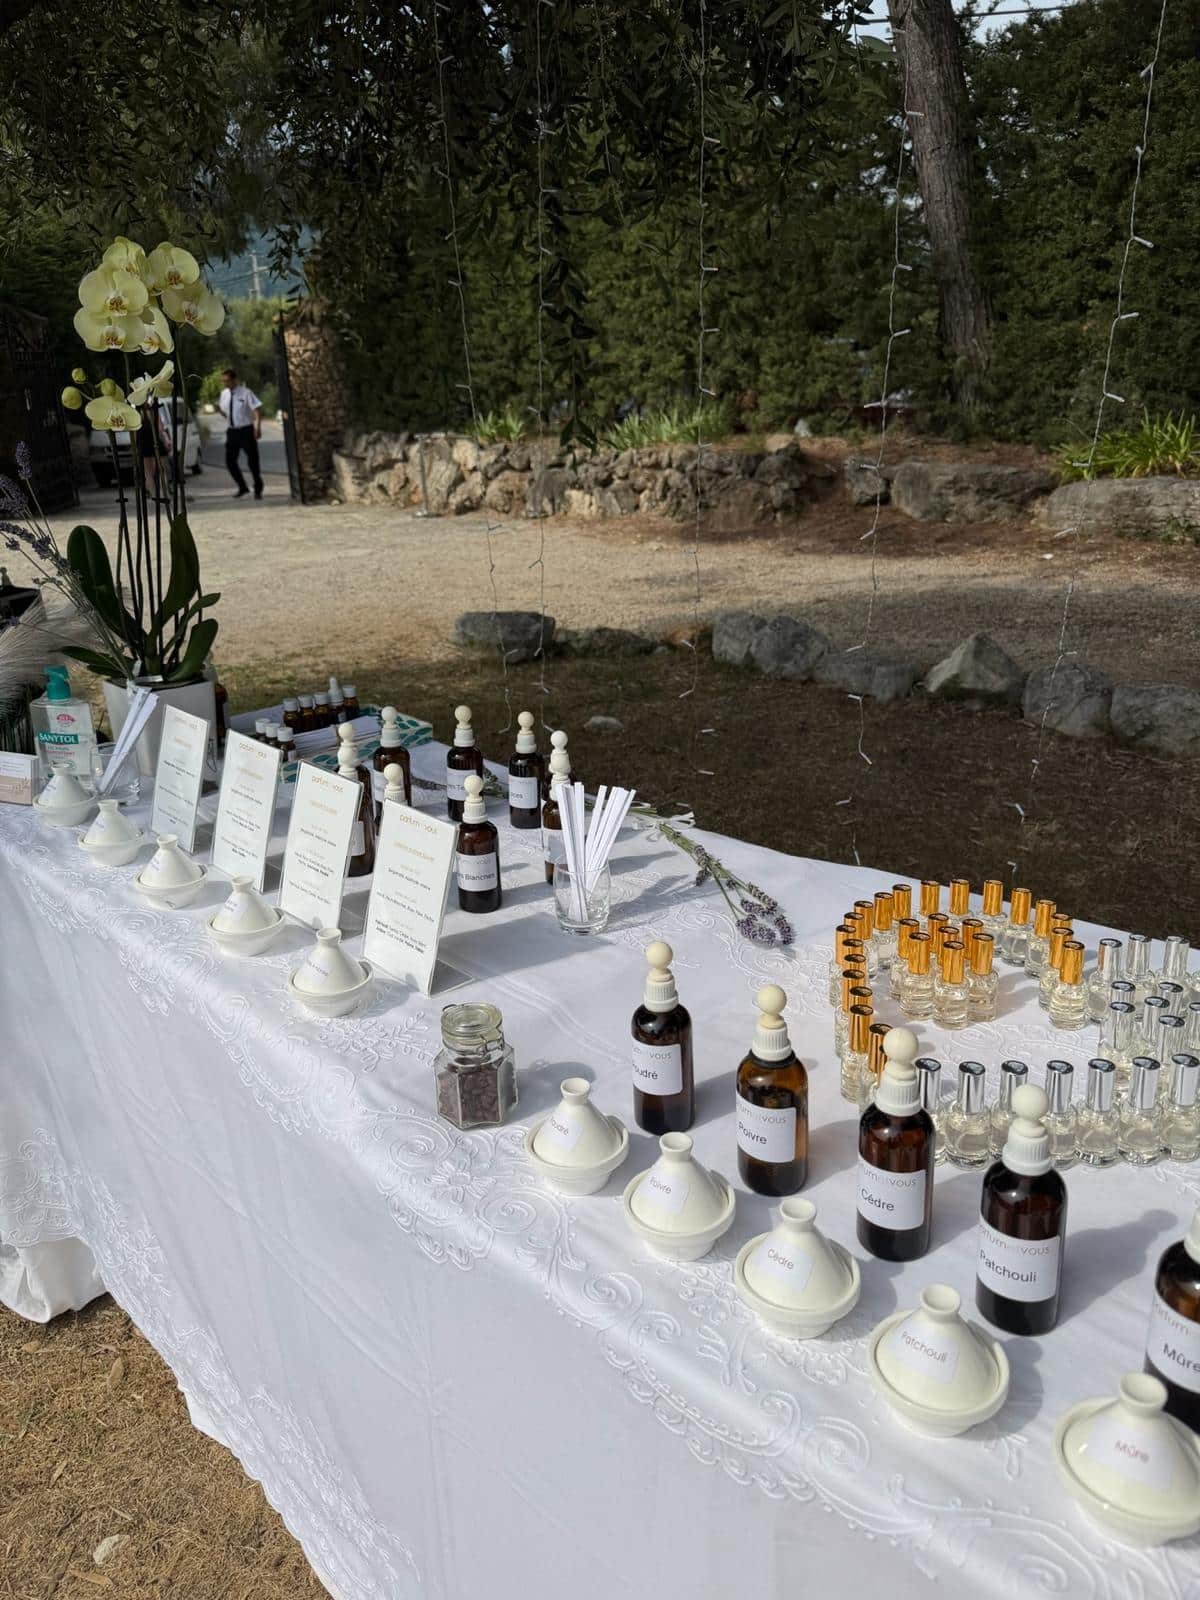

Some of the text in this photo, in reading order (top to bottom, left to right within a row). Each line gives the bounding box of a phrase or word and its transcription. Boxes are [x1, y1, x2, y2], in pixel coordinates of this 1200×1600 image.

[39, 733, 77, 743] SANYTOL
[464, 871, 496, 881] Blanches
[649, 1051, 672, 1061] vous
[761, 1115, 786, 1125] vous
[738, 1120, 768, 1144] Poivre
[888, 1177, 917, 1188] vous
[1021, 1246, 1049, 1256] vous
[979, 1248, 1038, 1283] Patchouli
[901, 1330, 947, 1363] Patchouli
